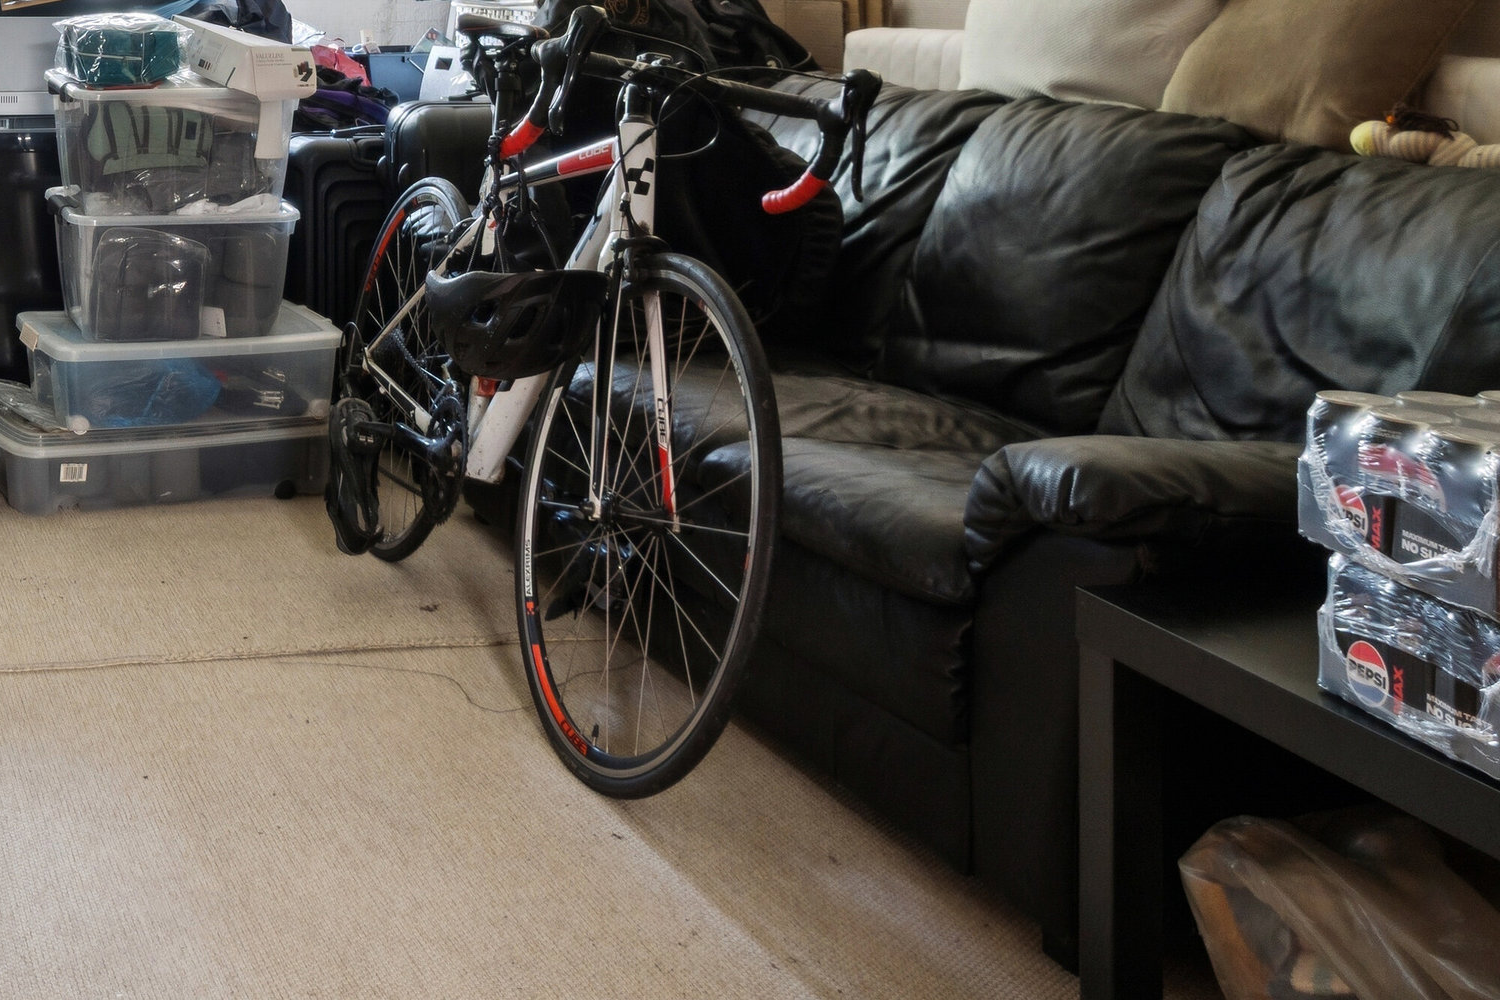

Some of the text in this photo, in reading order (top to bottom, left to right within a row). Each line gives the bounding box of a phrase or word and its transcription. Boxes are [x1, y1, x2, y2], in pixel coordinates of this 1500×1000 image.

[657, 398, 667, 443] CUBE
[1401, 538, 1417, 554] NO
[1349, 659, 1387, 690] PEPSI
[1393, 665, 1404, 715] MAX
[1426, 702, 1443, 720] NO
